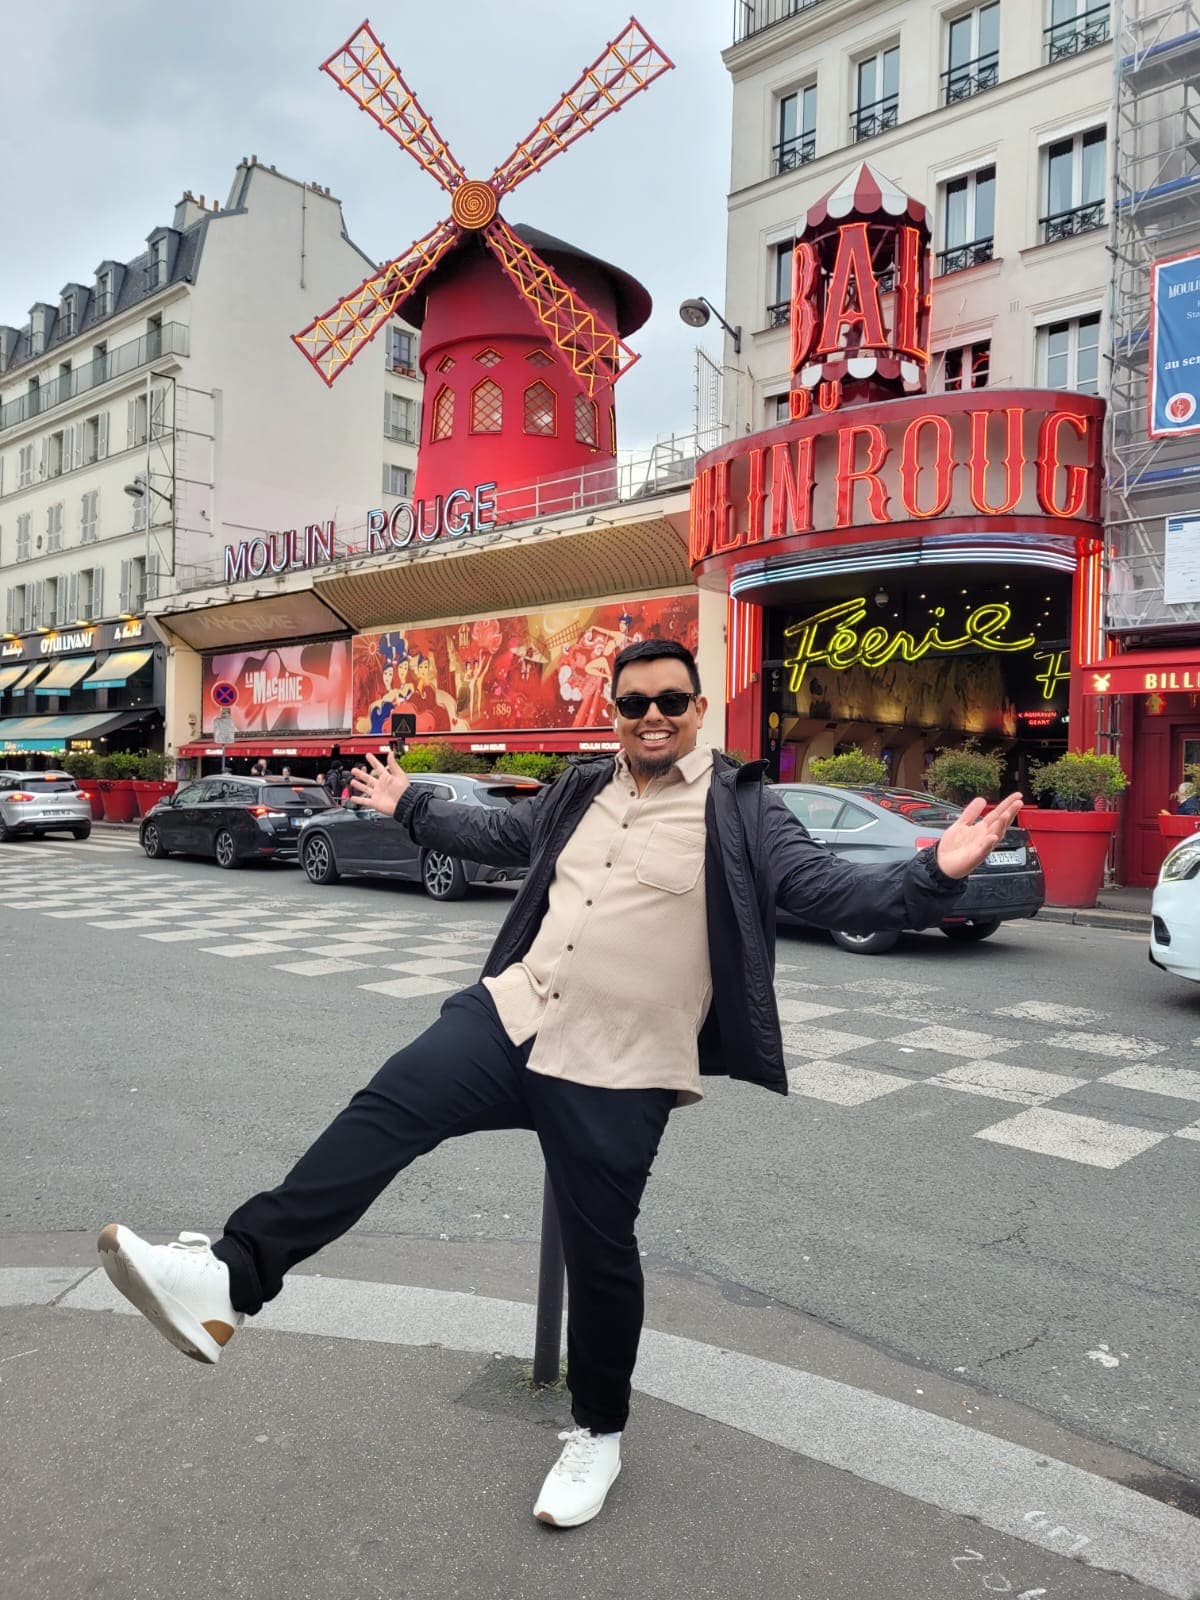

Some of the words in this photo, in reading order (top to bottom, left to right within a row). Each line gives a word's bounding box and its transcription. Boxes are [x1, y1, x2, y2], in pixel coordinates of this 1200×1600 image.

[1168, 280, 1200, 299] MOULI
[789, 222, 931, 379] BAL
[1164, 360, 1180, 371] au
[789, 380, 840, 420] DU
[224, 519, 335, 582] MOULIN
[367, 482, 498, 553] ROUGE
[1145, 671, 1200, 689] BILL
[492, 703, 512, 718] 1889
